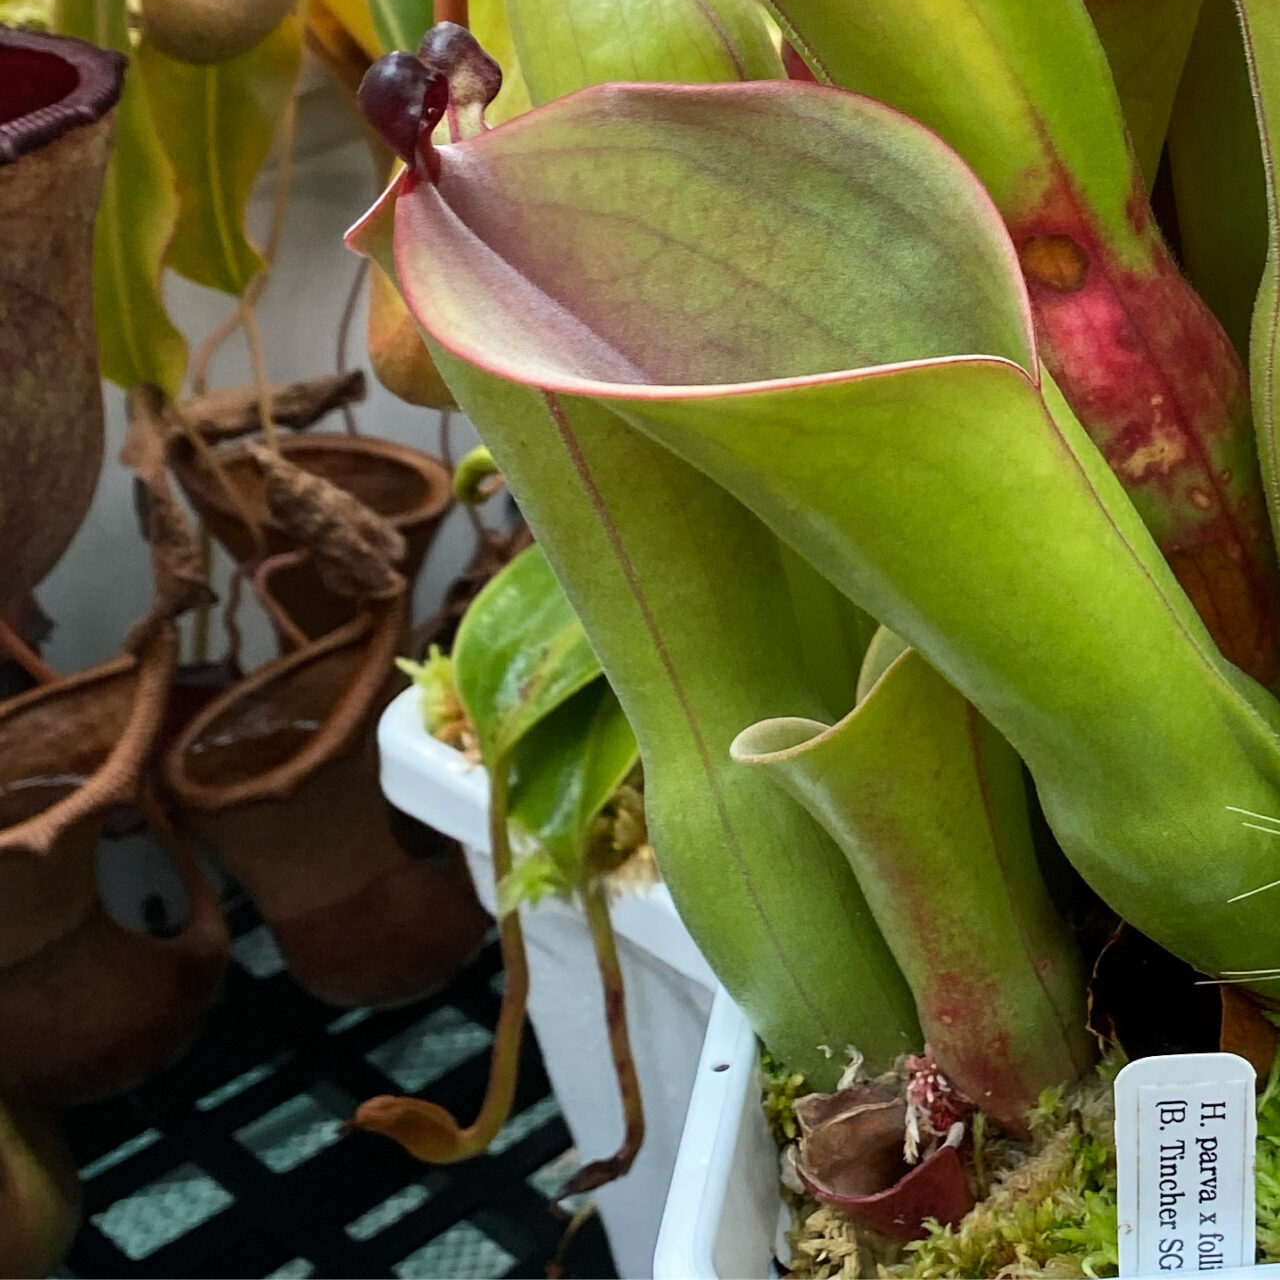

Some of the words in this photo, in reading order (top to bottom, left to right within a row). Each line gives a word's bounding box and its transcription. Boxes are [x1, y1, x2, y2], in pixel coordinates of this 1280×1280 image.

[1154, 1100, 1189, 1131] (B.
[1199, 1101, 1227, 1128] H.
[1158, 1139, 1186, 1230] Tincher
[1195, 1136, 1218, 1205] parva
[1199, 1211, 1217, 1226] x
[1158, 1238, 1184, 1271] SG
